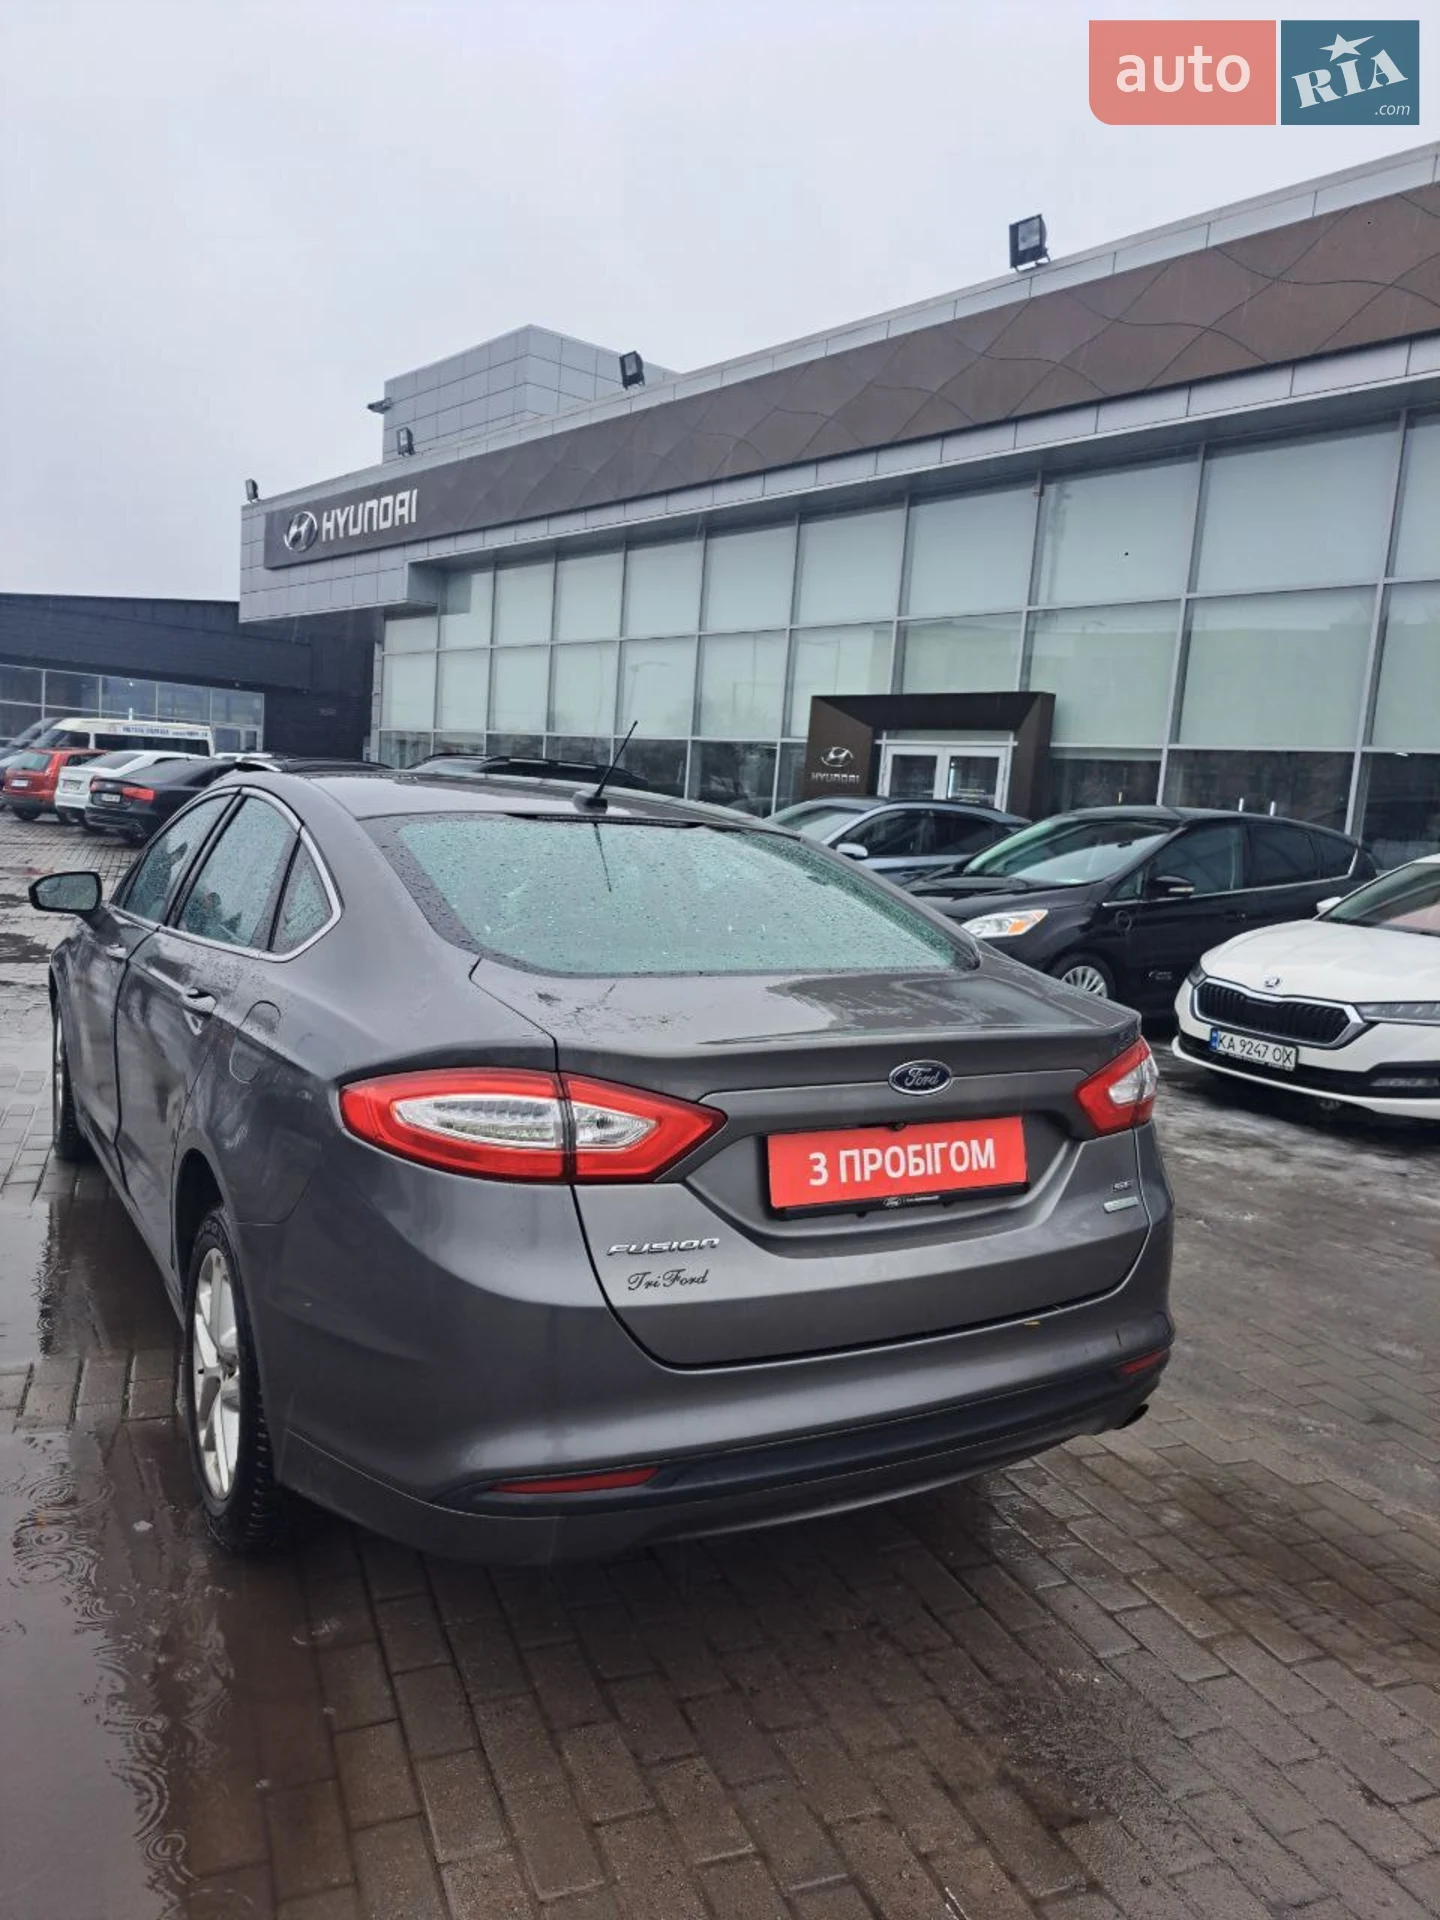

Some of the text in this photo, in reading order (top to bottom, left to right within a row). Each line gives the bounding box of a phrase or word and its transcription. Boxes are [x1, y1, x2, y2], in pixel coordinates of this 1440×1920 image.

[322, 488, 418, 542] HYUNDAI
[811, 772, 860, 784] HYUNDAI
[1218, 1035, 1293, 1065] KA 9247 OX
[904, 1067, 941, 1087] Ford
[839, 1138, 996, 1183] ПРОБІГОМ
[606, 1238, 720, 1256] FUSION
